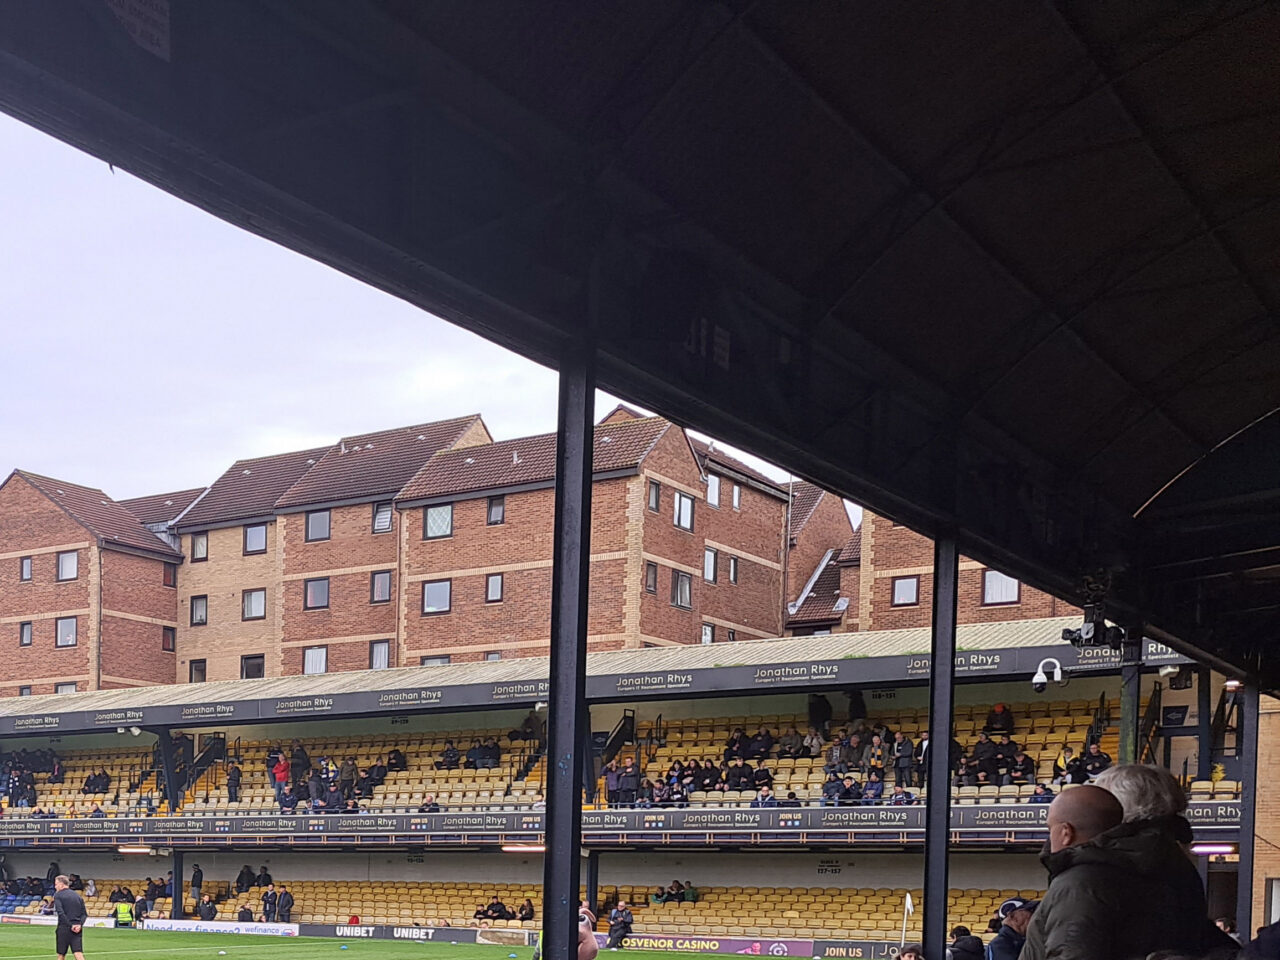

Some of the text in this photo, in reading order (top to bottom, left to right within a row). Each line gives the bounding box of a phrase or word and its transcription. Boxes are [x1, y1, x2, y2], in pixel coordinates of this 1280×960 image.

[970, 654, 1000, 664] Rhys
[754, 664, 839, 678] Jonathan Rhys
[616, 674, 692, 686] Jonathan Rhys
[492, 683, 549, 694] Jonathan Rh
[378, 690, 442, 701] Jonathan Rhys
[275, 698, 333, 709] Jonathan Rhys
[182, 705, 234, 715] Jonathan Rhys
[127, 711, 143, 720] Rhys
[44, 717, 59, 725] Rhys
[821, 811, 907, 821] Jonathan Rhys
[975, 810, 1034, 819] Jonathan
[1218, 806, 1241, 818] Rhy
[279, 819, 296, 827] Rhys
[378, 818, 397, 826] Rhys
[442, 816, 507, 825] Jonathan Rhys
[604, 815, 627, 823] Rhys
[683, 813, 760, 823] Jonathan Rhys
[336, 926, 374, 937] UNIBET
[393, 927, 435, 939] UNIBET
[676, 940, 719, 950] CASINO
[824, 947, 862, 957] JOIN US
